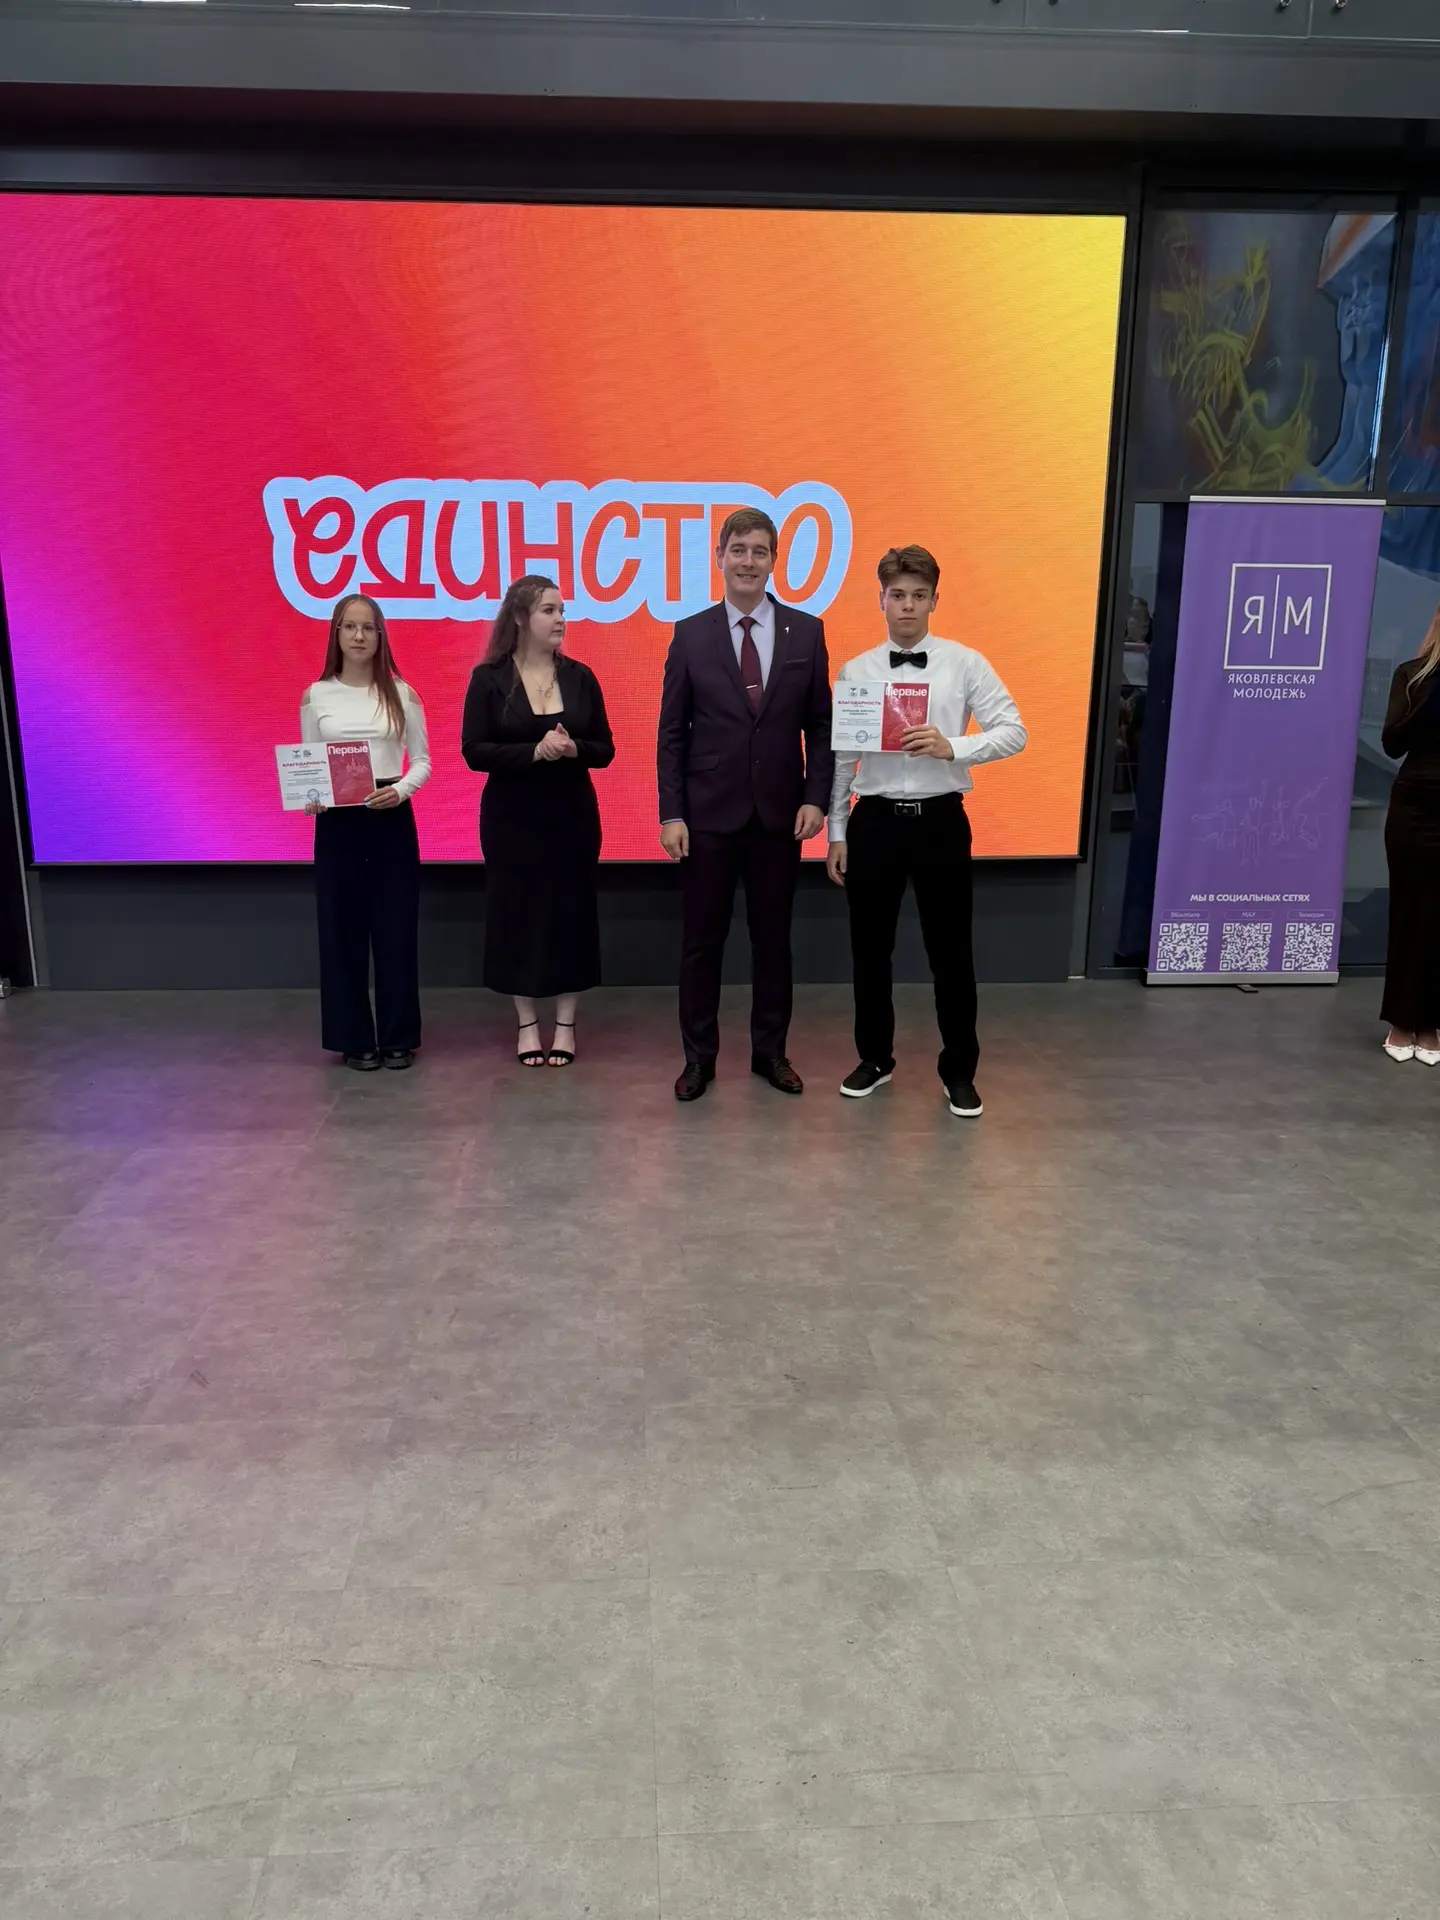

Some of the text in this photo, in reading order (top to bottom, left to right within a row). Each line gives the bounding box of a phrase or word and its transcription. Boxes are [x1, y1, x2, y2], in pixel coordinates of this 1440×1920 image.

[1228, 673, 1316, 685] ЯКОВЛЕВСКАЯ
[885, 688, 928, 698] Первые
[1233, 688, 1306, 700] МОЛОДЕЖЬ
[327, 745, 368, 756] Первые
[1190, 894, 1310, 903] МЫ В СОЦИАЛЬНЫХ СЕТЯХ
